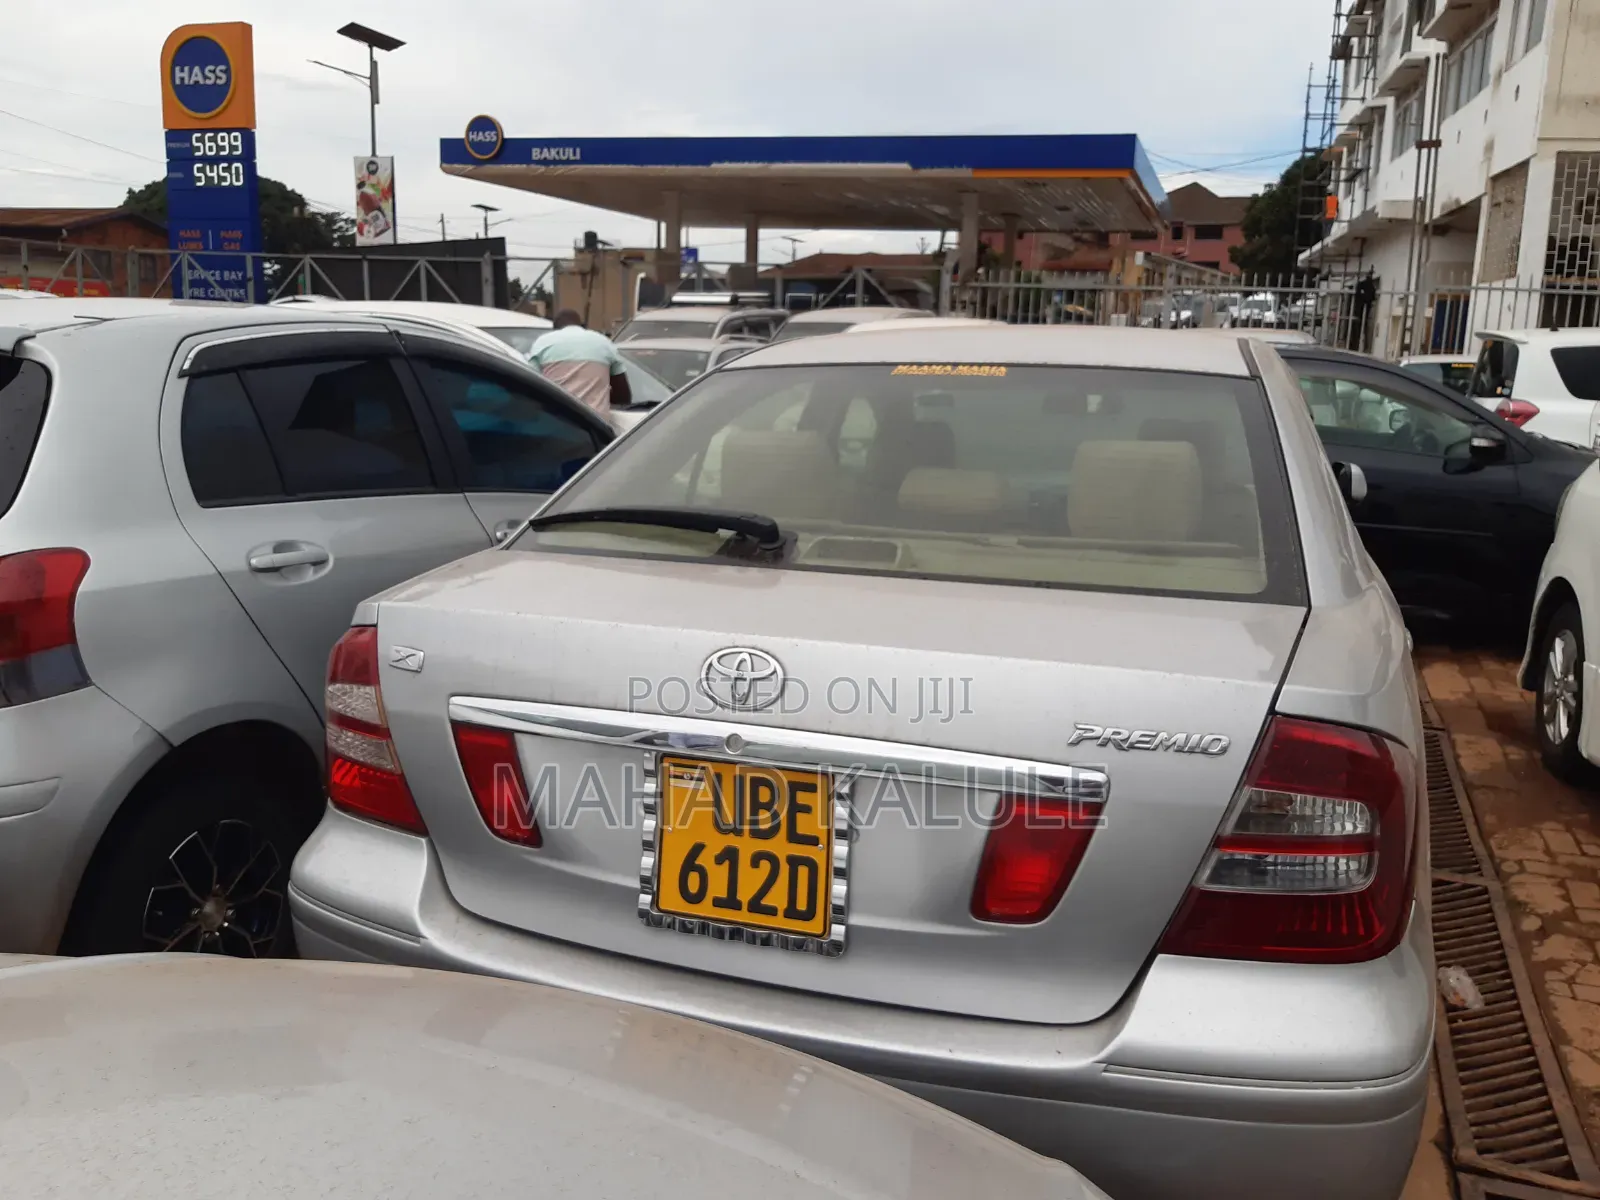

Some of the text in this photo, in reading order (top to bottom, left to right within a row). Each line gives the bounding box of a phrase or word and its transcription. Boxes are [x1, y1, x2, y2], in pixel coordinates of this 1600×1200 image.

[174, 65, 228, 86] HASS
[192, 131, 242, 156] 5699
[468, 130, 498, 143] HASS
[531, 147, 580, 160] BAKULI
[193, 162, 244, 187] 5450
[223, 269, 244, 281] BAY
[187, 286, 206, 298] YRE
[1066, 722, 1232, 756] PREMIO
[712, 772, 821, 847] UBE
[677, 841, 820, 922] 612D
